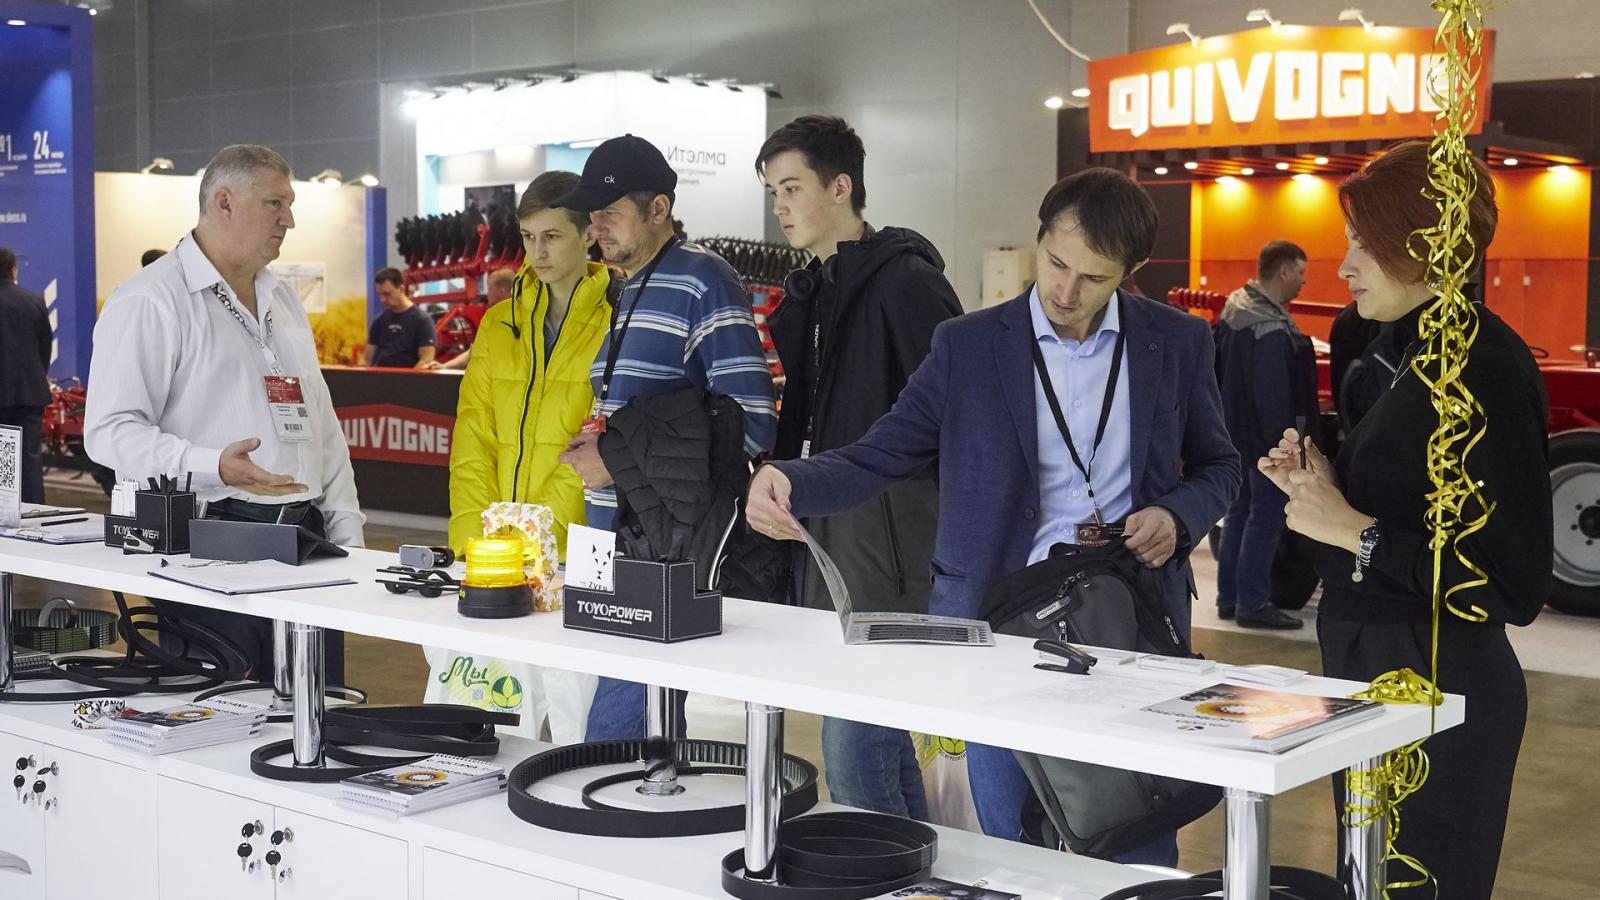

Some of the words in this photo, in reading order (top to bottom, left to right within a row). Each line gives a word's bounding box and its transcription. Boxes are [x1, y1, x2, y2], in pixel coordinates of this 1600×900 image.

[1109, 51, 1456, 137] QUIVOGNE
[33, 130, 50, 160] 24
[667, 145, 726, 166] Итэлма
[604, 175, 615, 185] ck
[340, 416, 449, 454] UIVOGNE
[113, 524, 160, 540] TOYWER
[577, 600, 652, 622] TOYOPOWER
[438, 656, 490, 688] Мы
